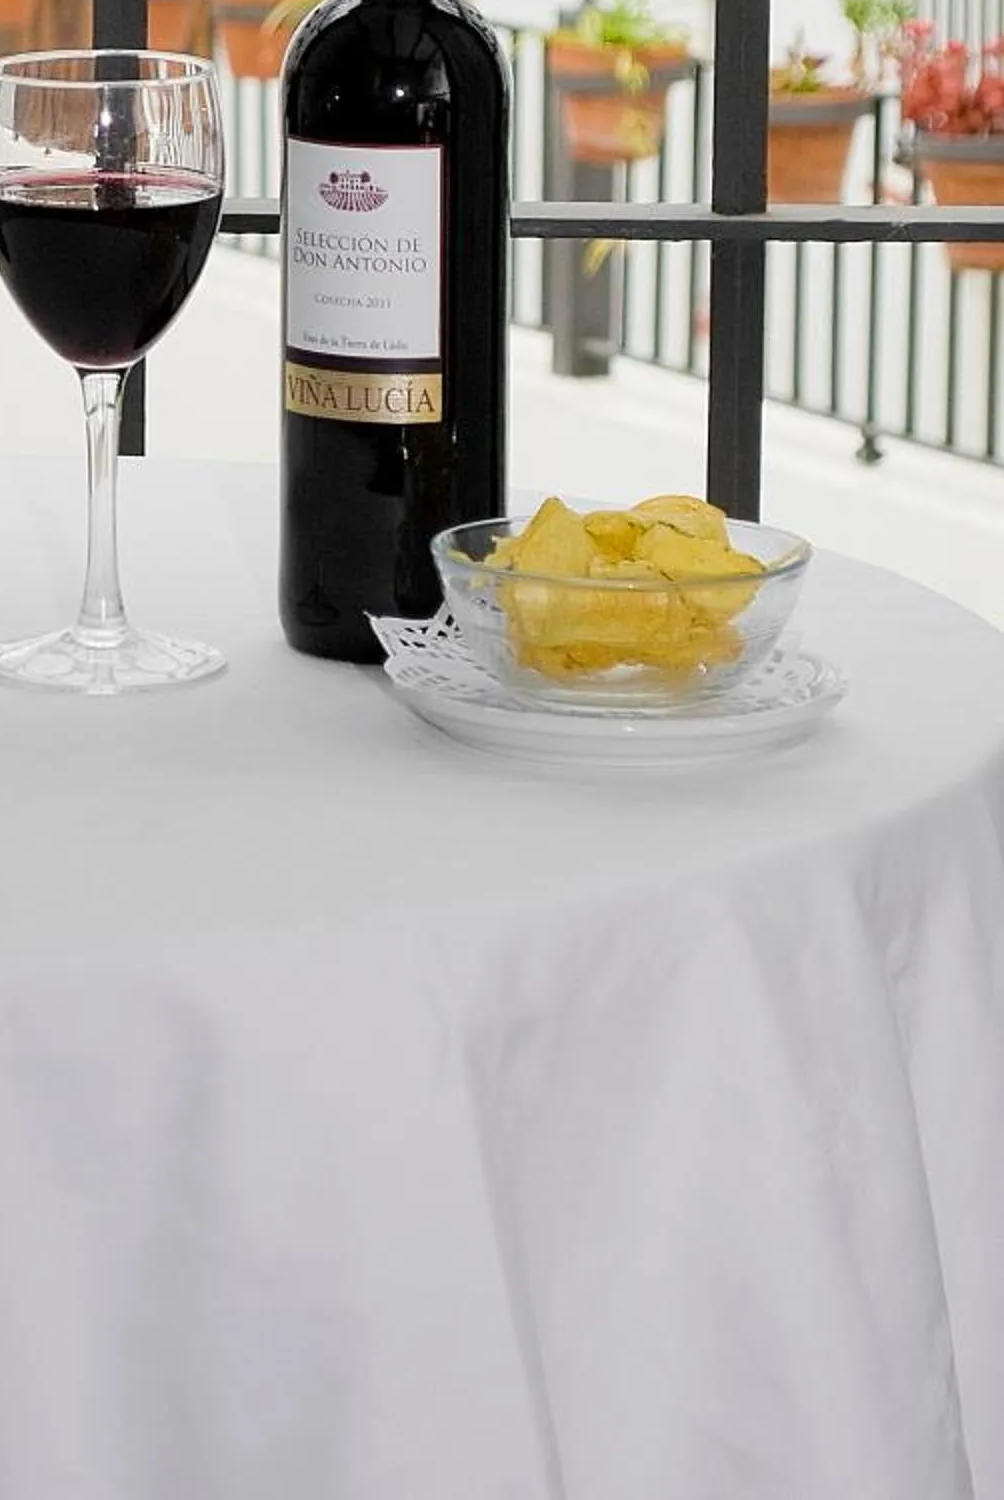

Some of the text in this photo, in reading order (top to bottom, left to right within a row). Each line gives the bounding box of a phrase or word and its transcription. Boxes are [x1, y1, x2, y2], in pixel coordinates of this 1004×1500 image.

[296, 228, 421, 253] SELECCIÓN DE
[294, 247, 427, 272] DON ANTONIO
[314, 293, 391, 309] COSECHA 2011
[287, 373, 436, 413] VIÑA LUCÍA
